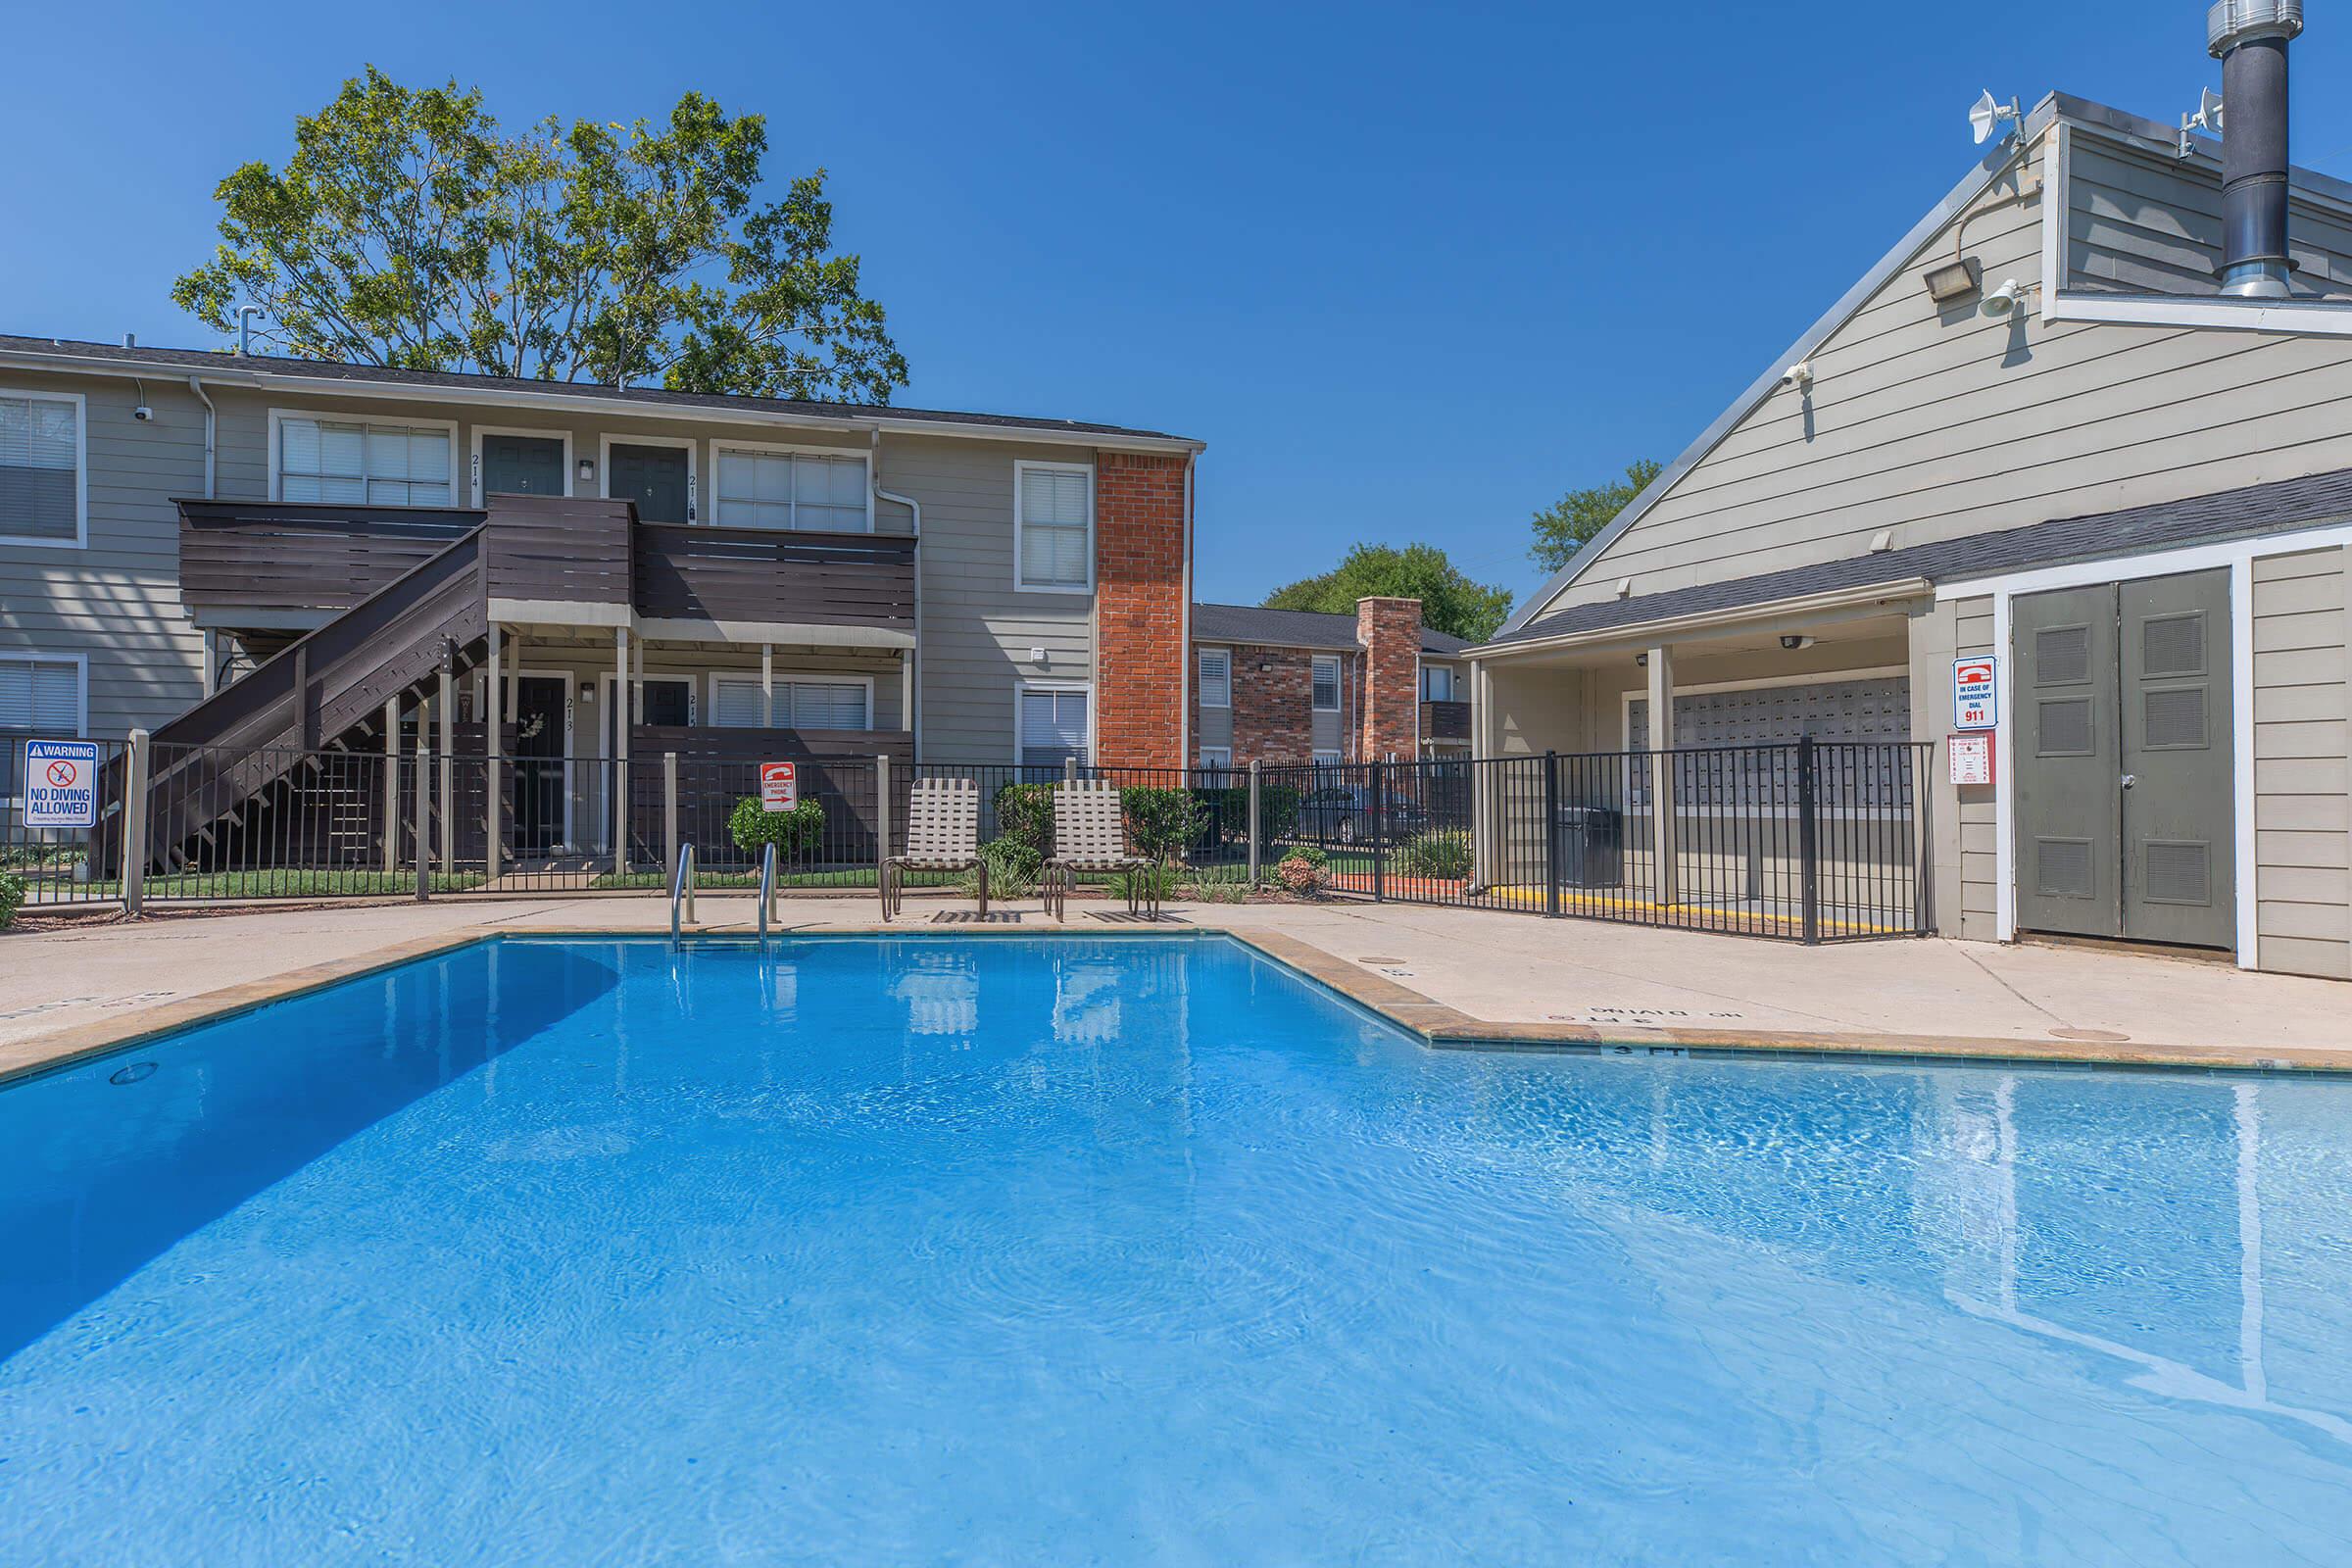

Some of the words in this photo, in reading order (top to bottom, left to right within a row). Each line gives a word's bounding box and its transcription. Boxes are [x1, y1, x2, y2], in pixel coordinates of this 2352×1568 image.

[1959, 693, 1991, 702] EMERGENCY
[1965, 710, 1984, 722] 911
[43, 745, 94, 758] WARNING
[30, 788, 48, 801] NO
[50, 788, 90, 802] DIVING
[30, 802, 88, 814] ALLOWED
[1591, 1007, 1689, 1016] DIVING
[1649, 1047, 1686, 1056] FT
